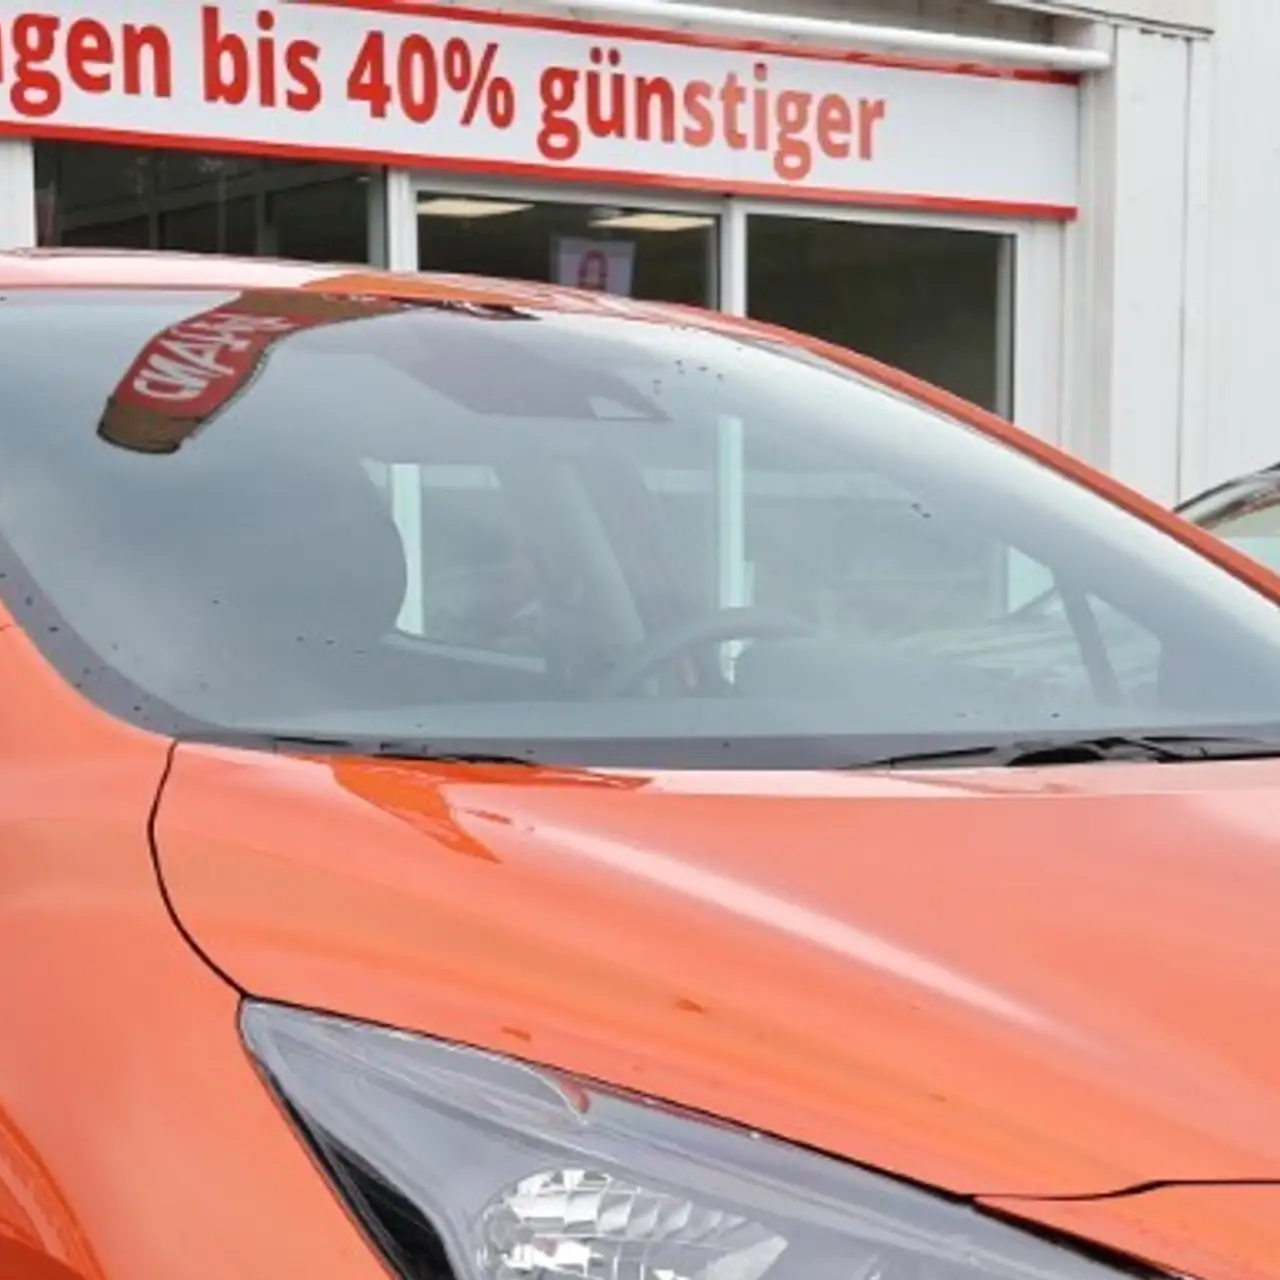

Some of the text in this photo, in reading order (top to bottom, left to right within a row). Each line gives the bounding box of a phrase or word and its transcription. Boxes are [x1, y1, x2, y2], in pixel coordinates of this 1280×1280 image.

[202, 6, 321, 113] bis
[347, 30, 515, 129] 40%
[535, 47, 886, 181] günstiger
